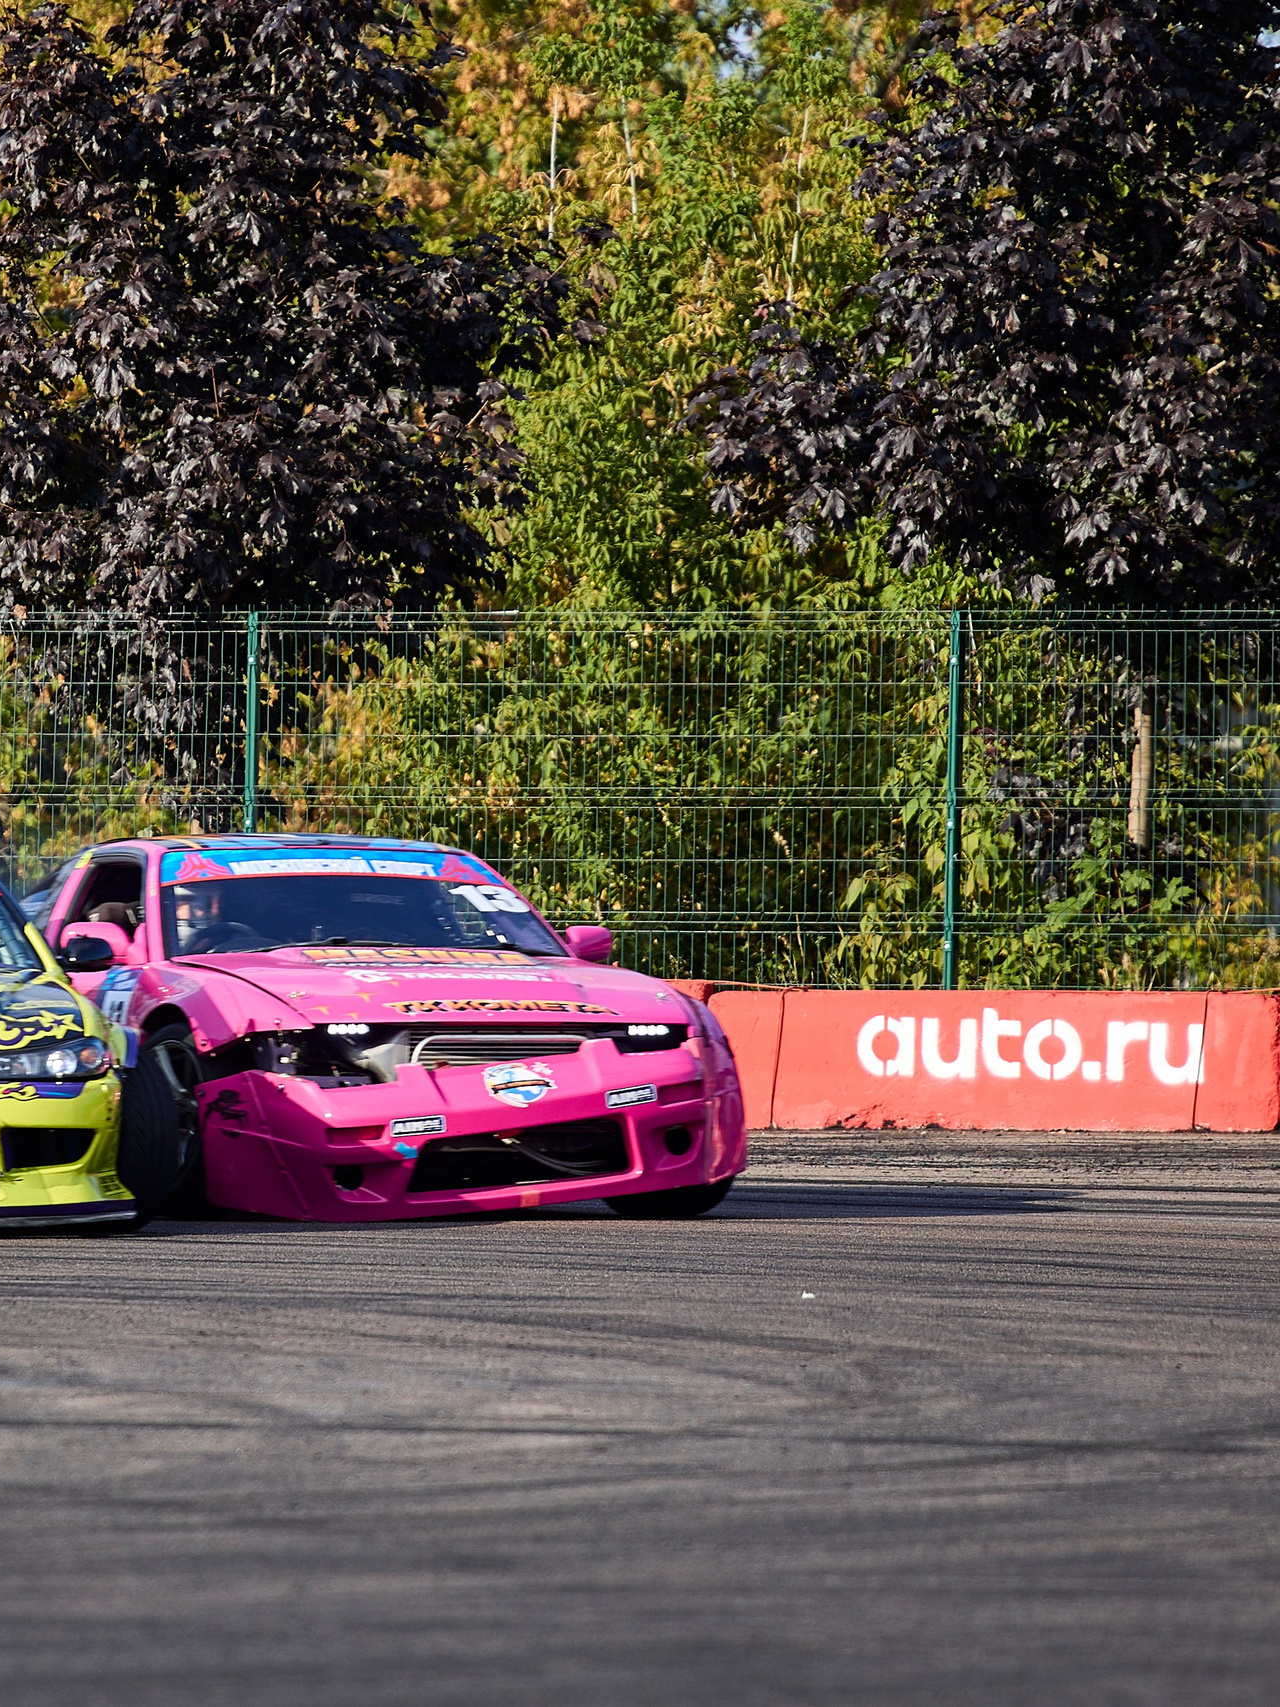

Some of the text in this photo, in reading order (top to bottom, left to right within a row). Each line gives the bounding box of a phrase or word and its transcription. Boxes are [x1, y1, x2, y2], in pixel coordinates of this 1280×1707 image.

[449, 885, 531, 913] 13
[301, 950, 542, 966] MASUMA
[857, 1007, 1205, 1085] auto.ru
